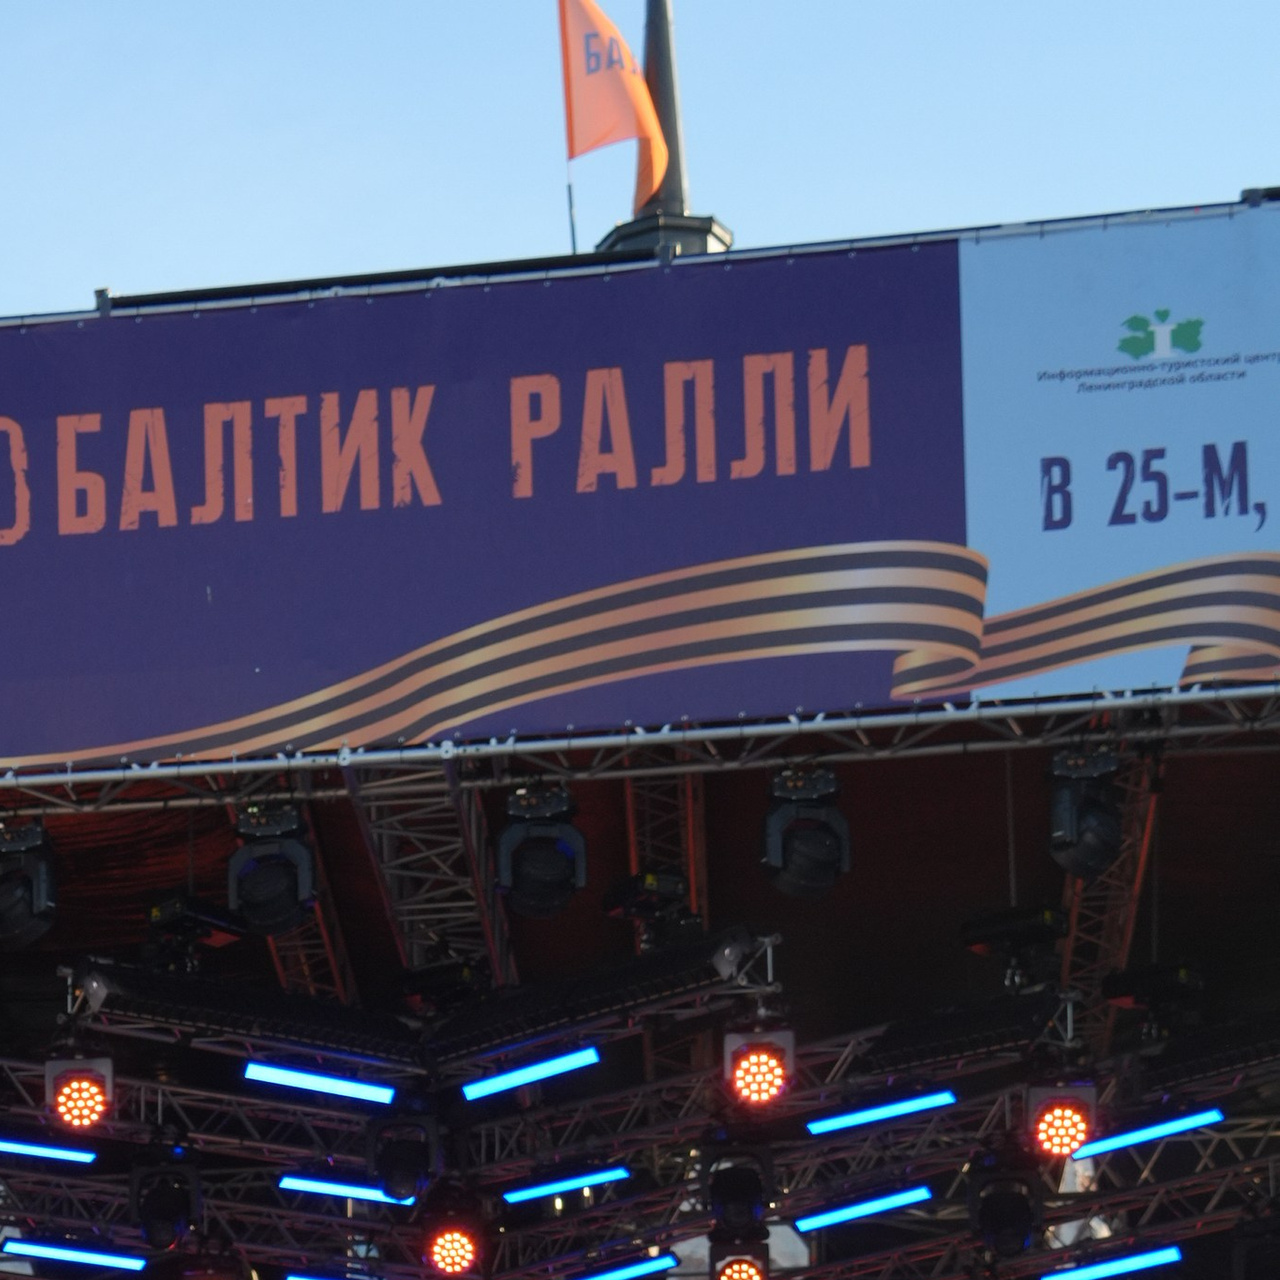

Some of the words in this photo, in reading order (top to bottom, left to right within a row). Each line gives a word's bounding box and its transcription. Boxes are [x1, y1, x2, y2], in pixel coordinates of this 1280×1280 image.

[56, 384, 442, 536] БАЛТИК
[509, 344, 871, 499] РАЛЛИ
[1040, 456, 1073, 532] В
